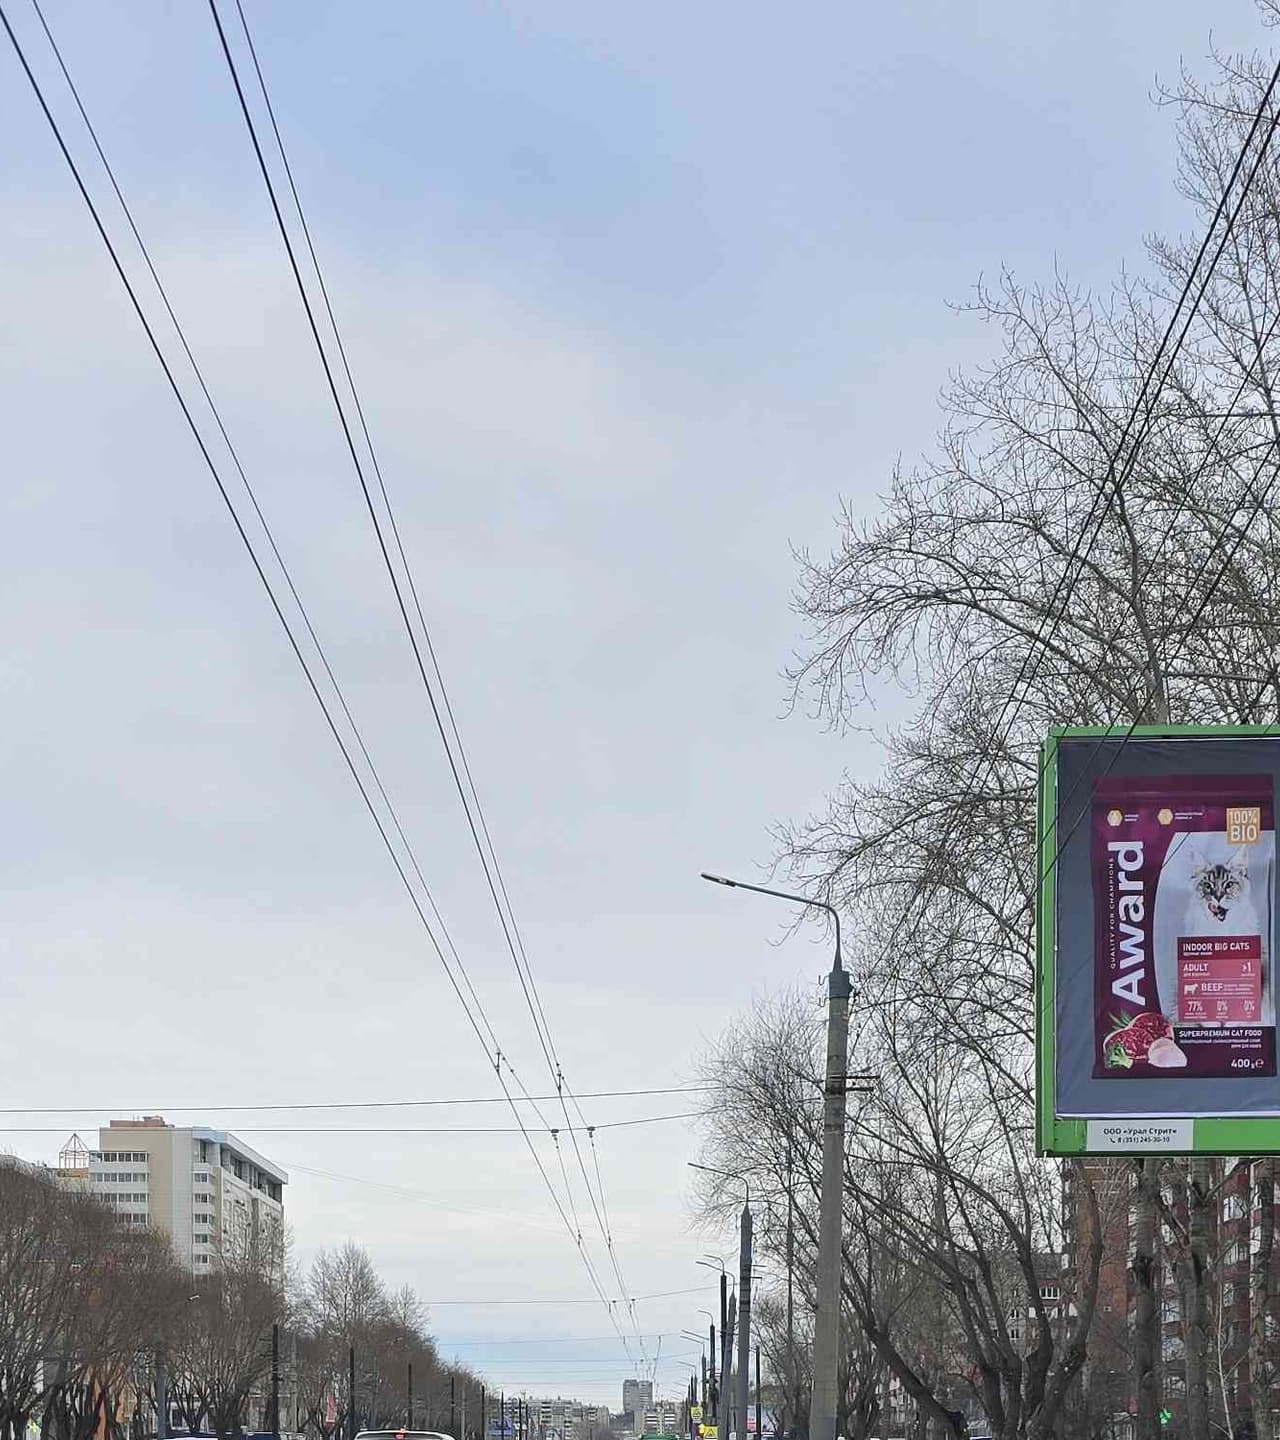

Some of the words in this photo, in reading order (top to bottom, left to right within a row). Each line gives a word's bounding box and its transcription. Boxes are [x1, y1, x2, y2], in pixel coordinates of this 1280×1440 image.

[1230, 810, 1258, 824] 100%
[1231, 825, 1257, 841] BIO
[1107, 841, 1146, 1006] Award
[1183, 943, 1213, 951] INDOOR
[1214, 943, 1228, 951] BIG
[1229, 942, 1250, 950] CATS
[1183, 963, 1209, 971] ADULT
